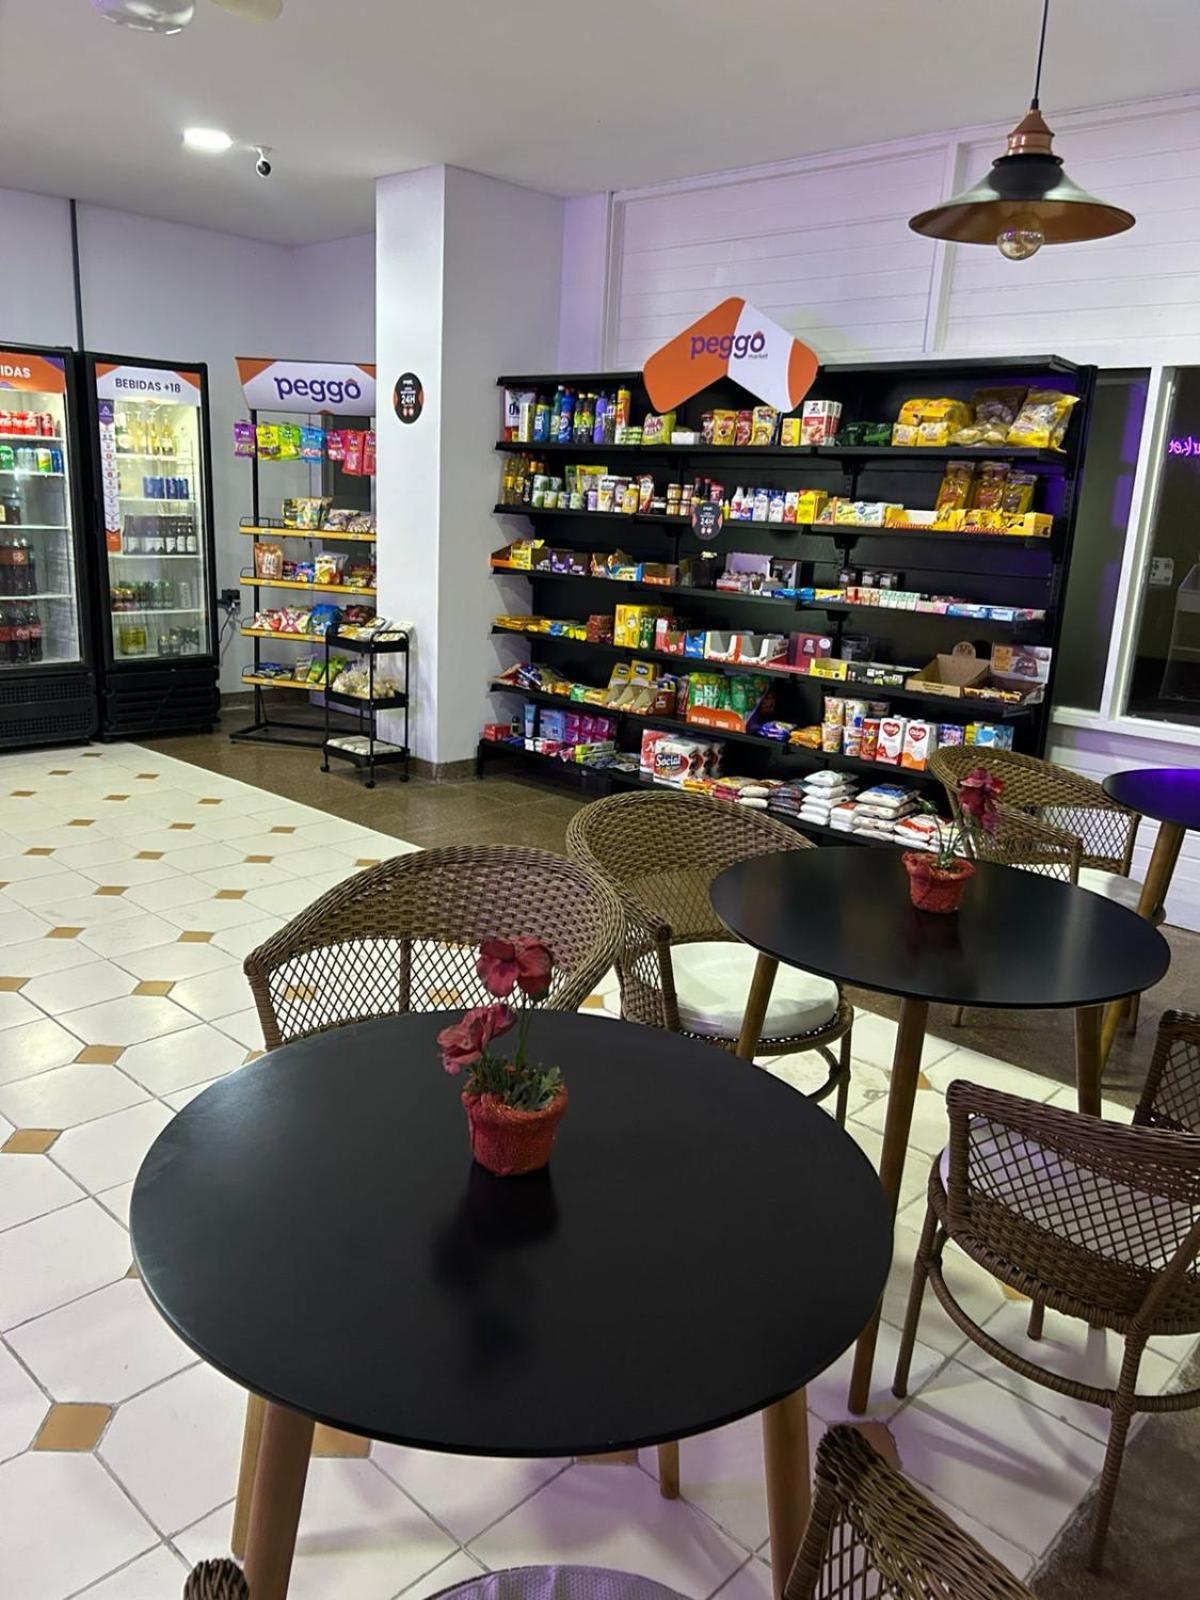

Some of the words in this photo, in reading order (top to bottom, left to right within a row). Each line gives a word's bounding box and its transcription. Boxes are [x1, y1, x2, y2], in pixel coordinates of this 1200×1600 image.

[115, 377, 162, 391] BEBIDAS
[163, 383, 181, 393] +18
[400, 394, 416, 405] 24H
